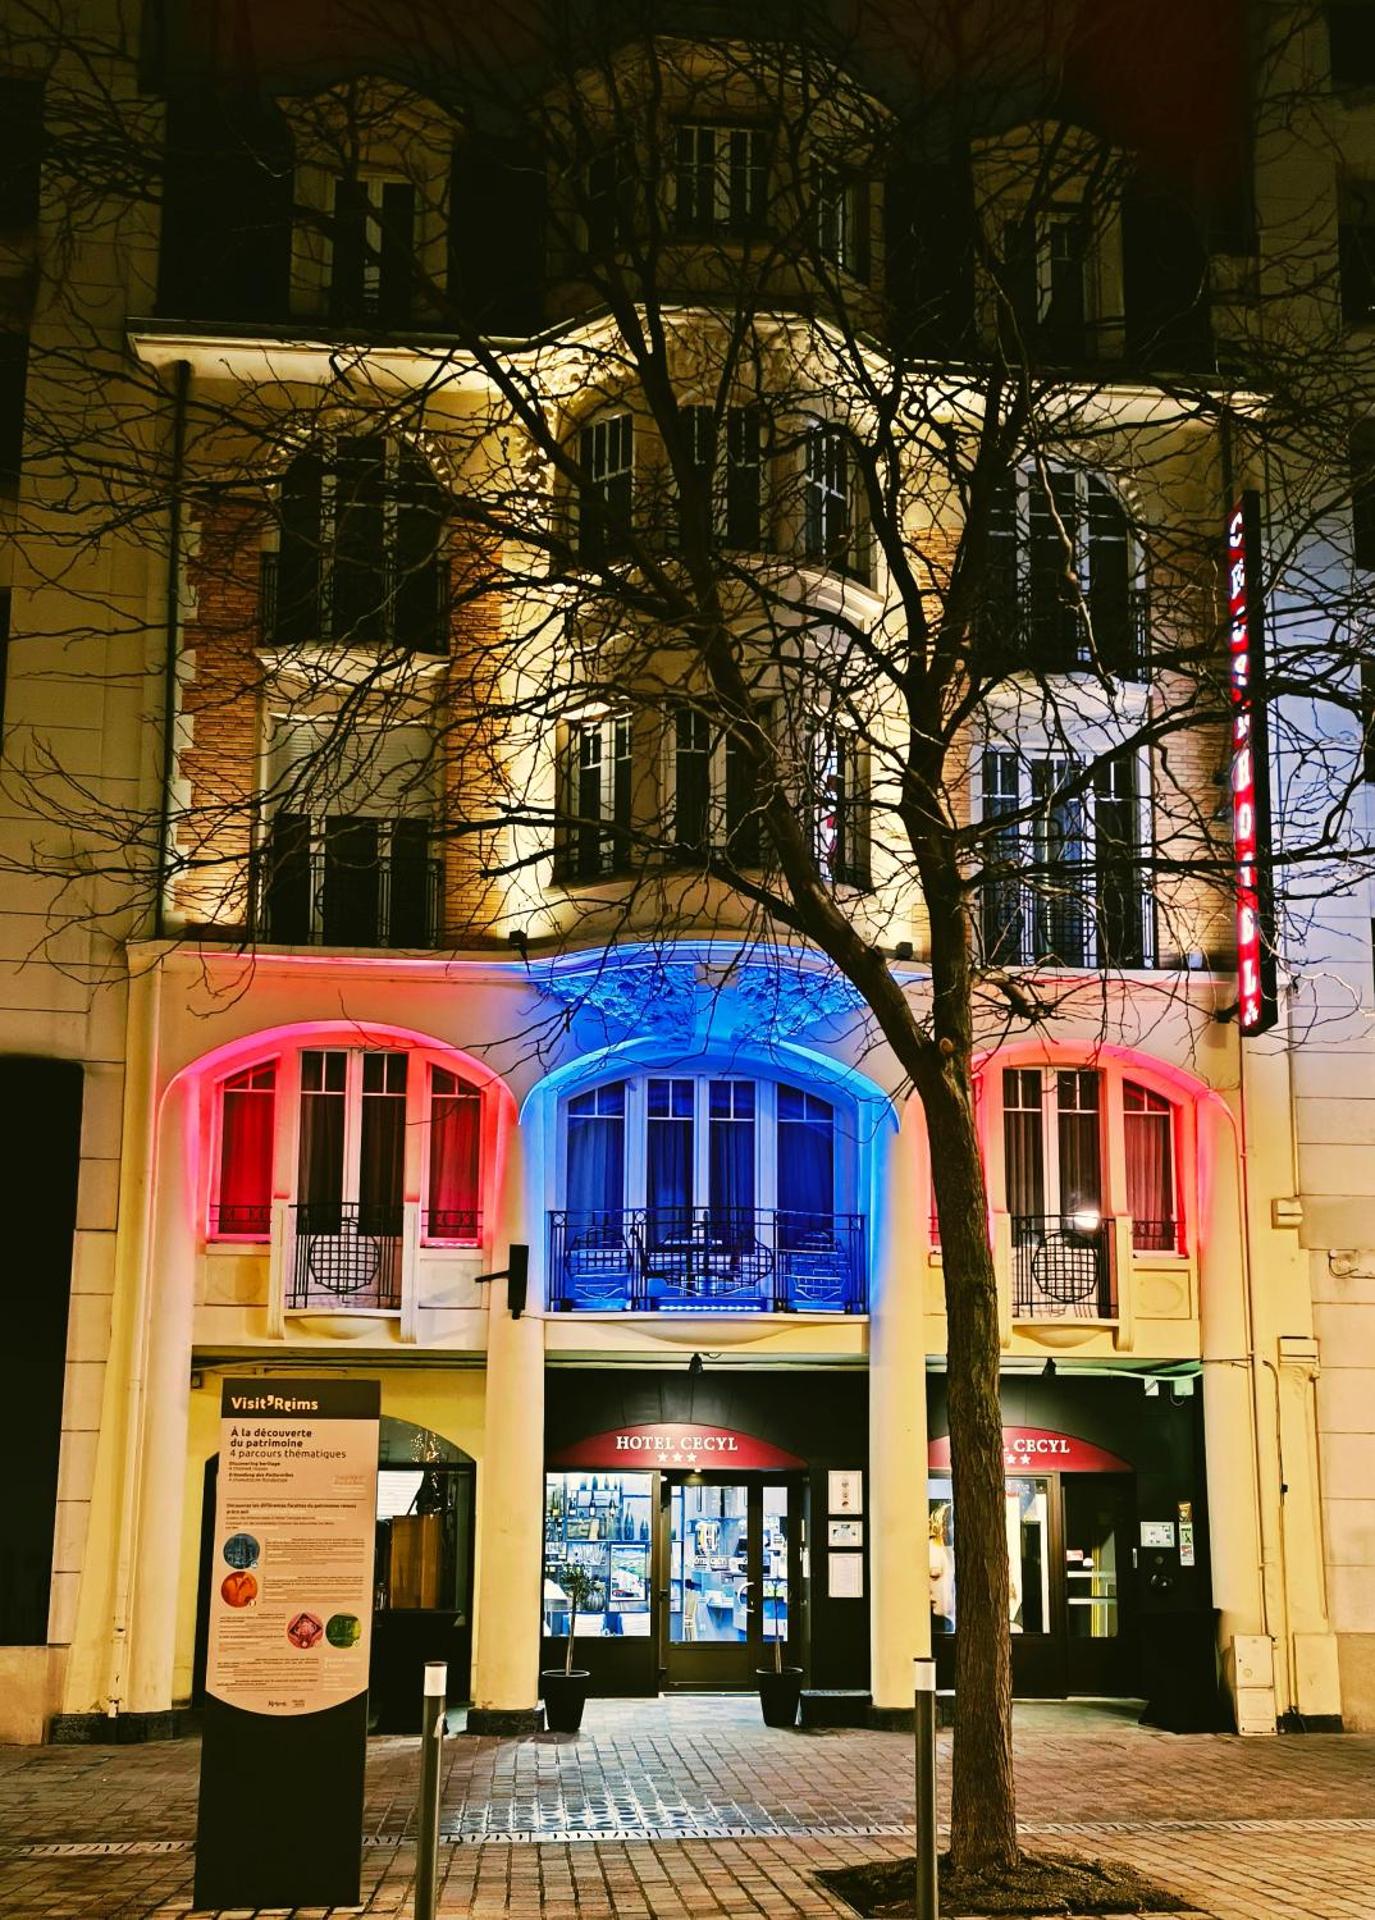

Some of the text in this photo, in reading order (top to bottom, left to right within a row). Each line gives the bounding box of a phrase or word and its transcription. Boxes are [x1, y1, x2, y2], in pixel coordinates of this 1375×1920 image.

[241, 1428, 251, 1437] la
[254, 1428, 312, 1438] découverte
[230, 1438, 303, 1449] du patrimoine
[616, 1436, 738, 1451] HOTEL CECYL
[1014, 1439, 1070, 1453] CECYL
[230, 1449, 346, 1459] 4 parcours thématiques
